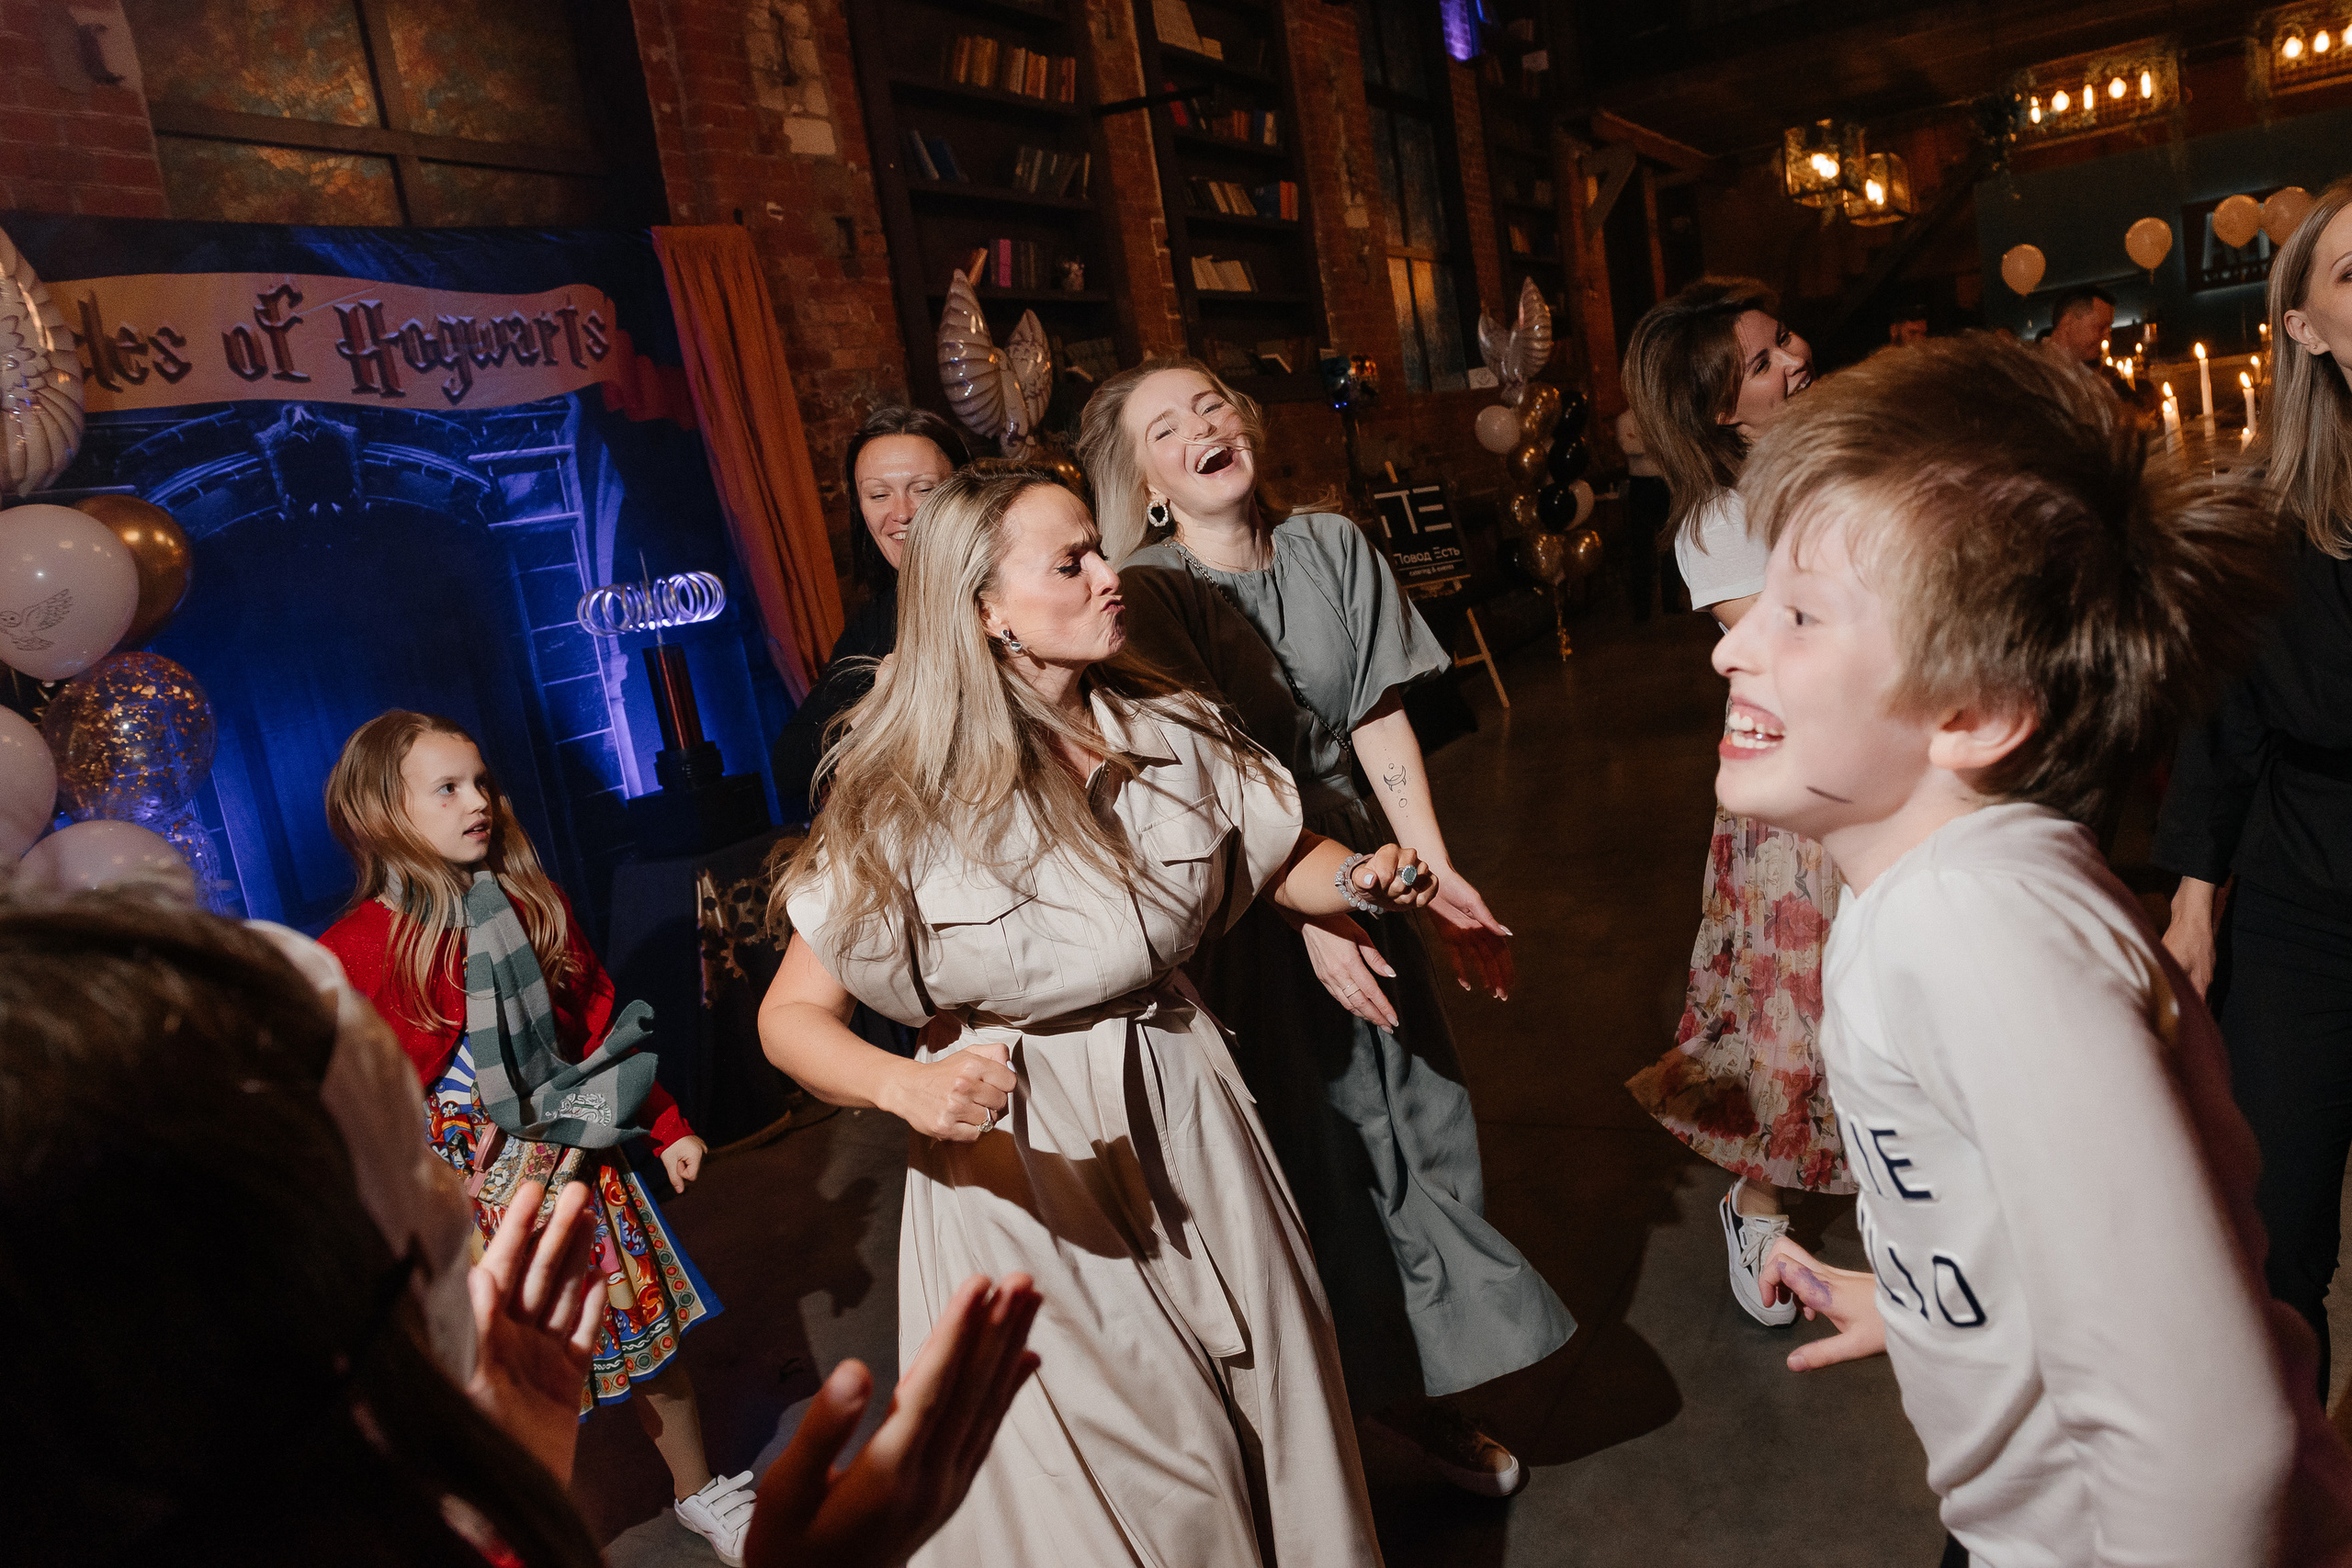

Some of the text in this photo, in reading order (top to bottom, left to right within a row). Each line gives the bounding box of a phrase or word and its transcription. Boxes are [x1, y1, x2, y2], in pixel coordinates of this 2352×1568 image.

[71, 280, 611, 406] les of Hogwarts
[1394, 547, 1460, 565] Повод Есть
